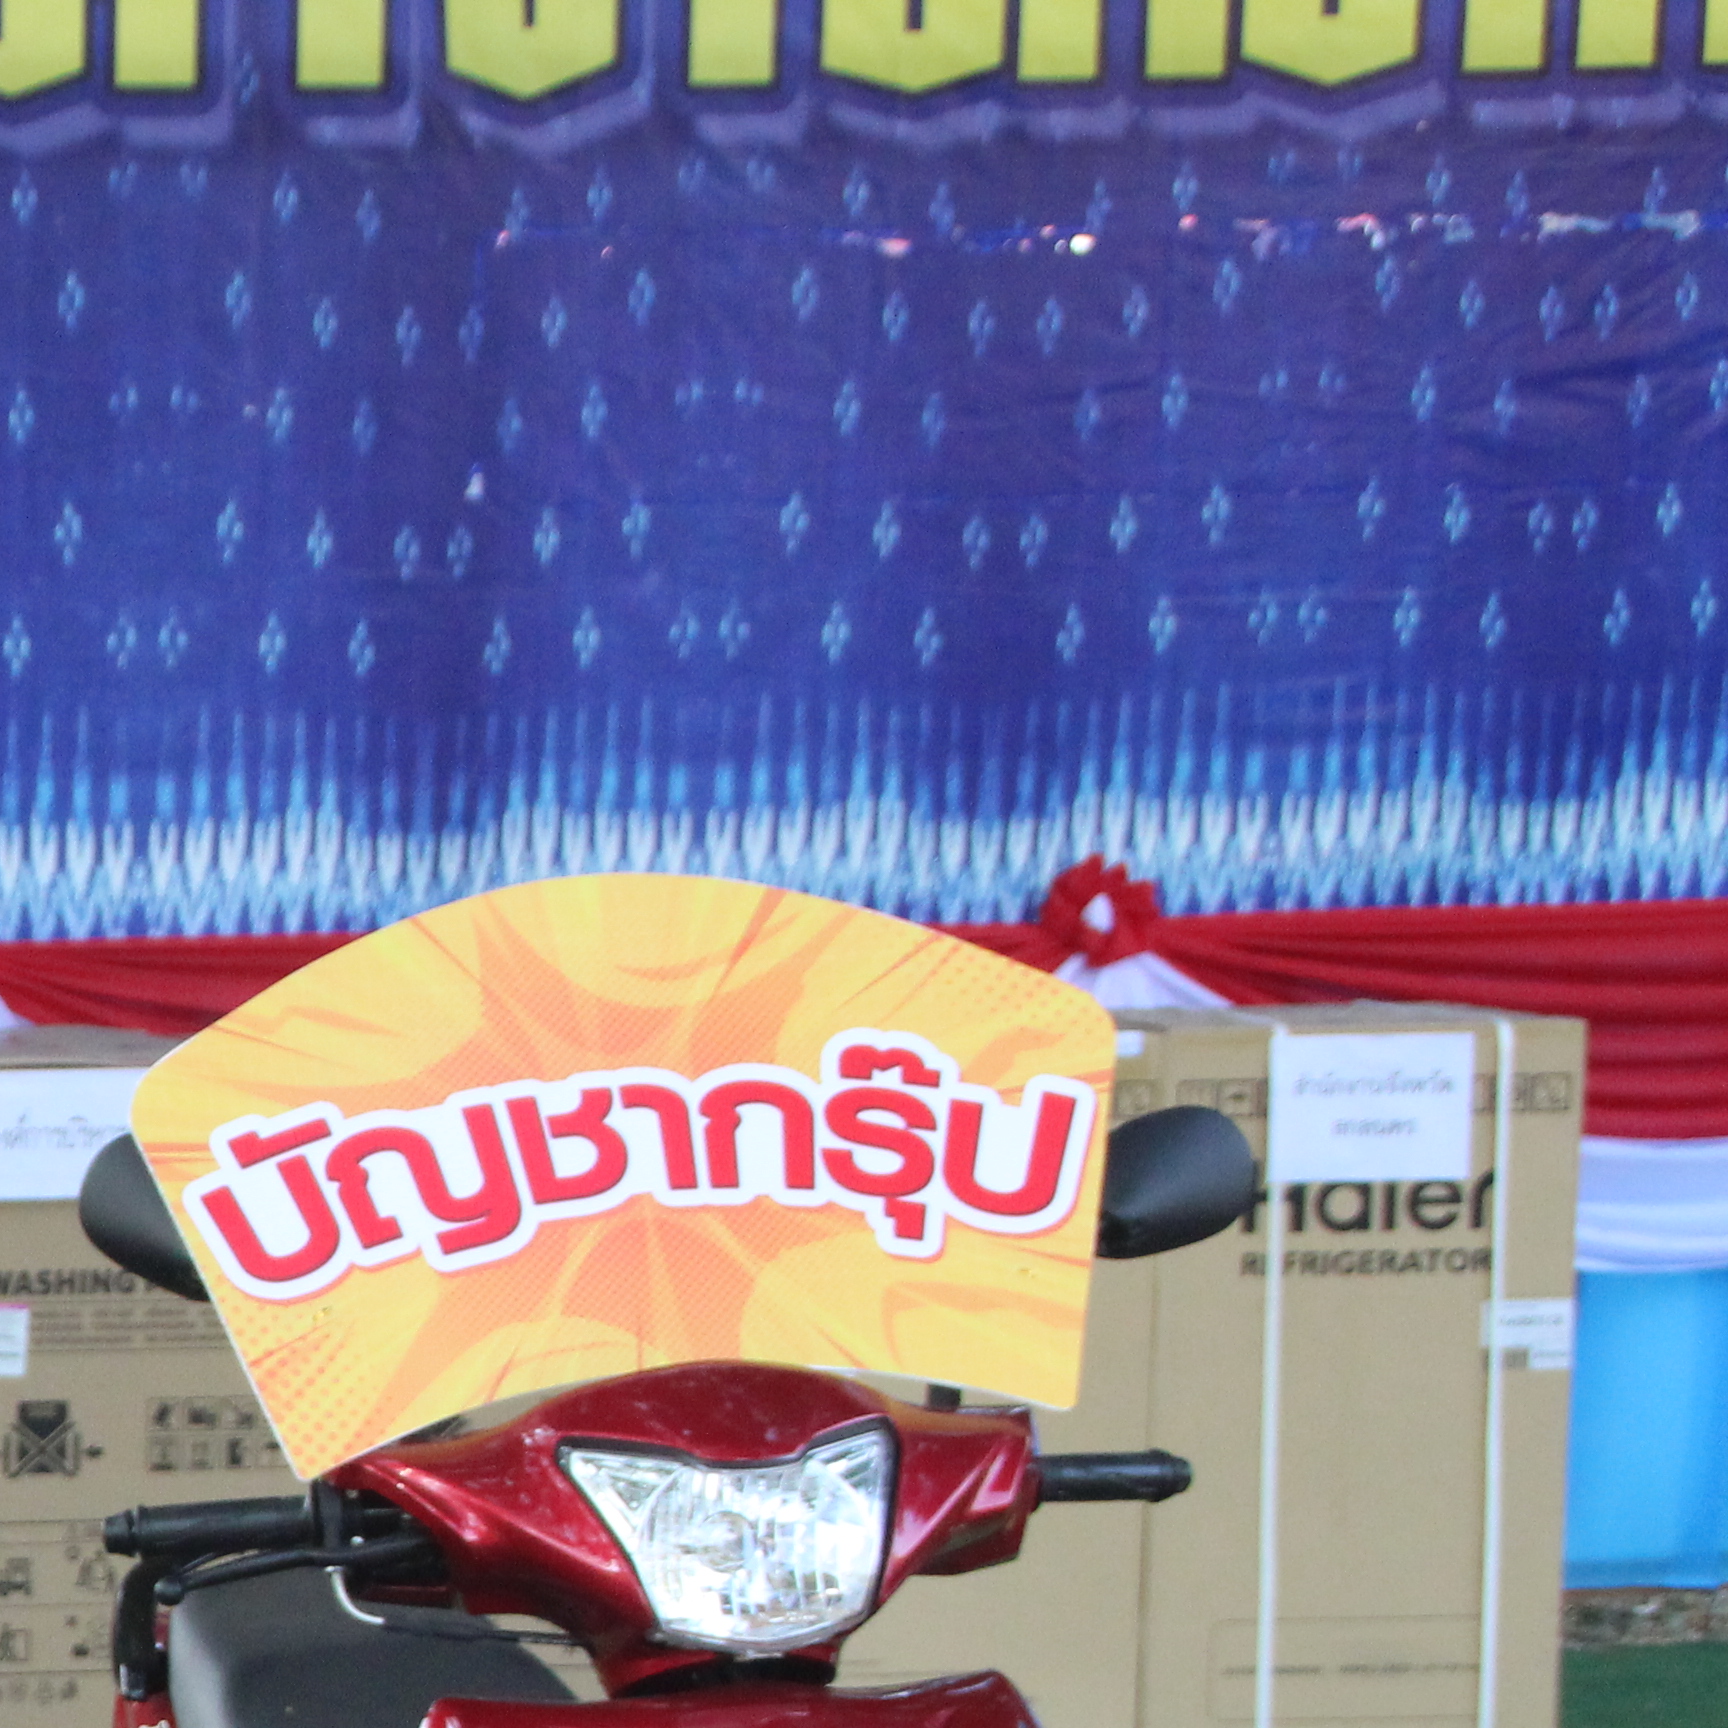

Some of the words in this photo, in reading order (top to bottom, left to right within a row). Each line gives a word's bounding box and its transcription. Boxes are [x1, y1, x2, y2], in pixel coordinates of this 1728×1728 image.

[199, 1043, 1080, 1284] บัญชากรุ๊ป
[1241, 1250, 1492, 1276] RFRIGERATOR
